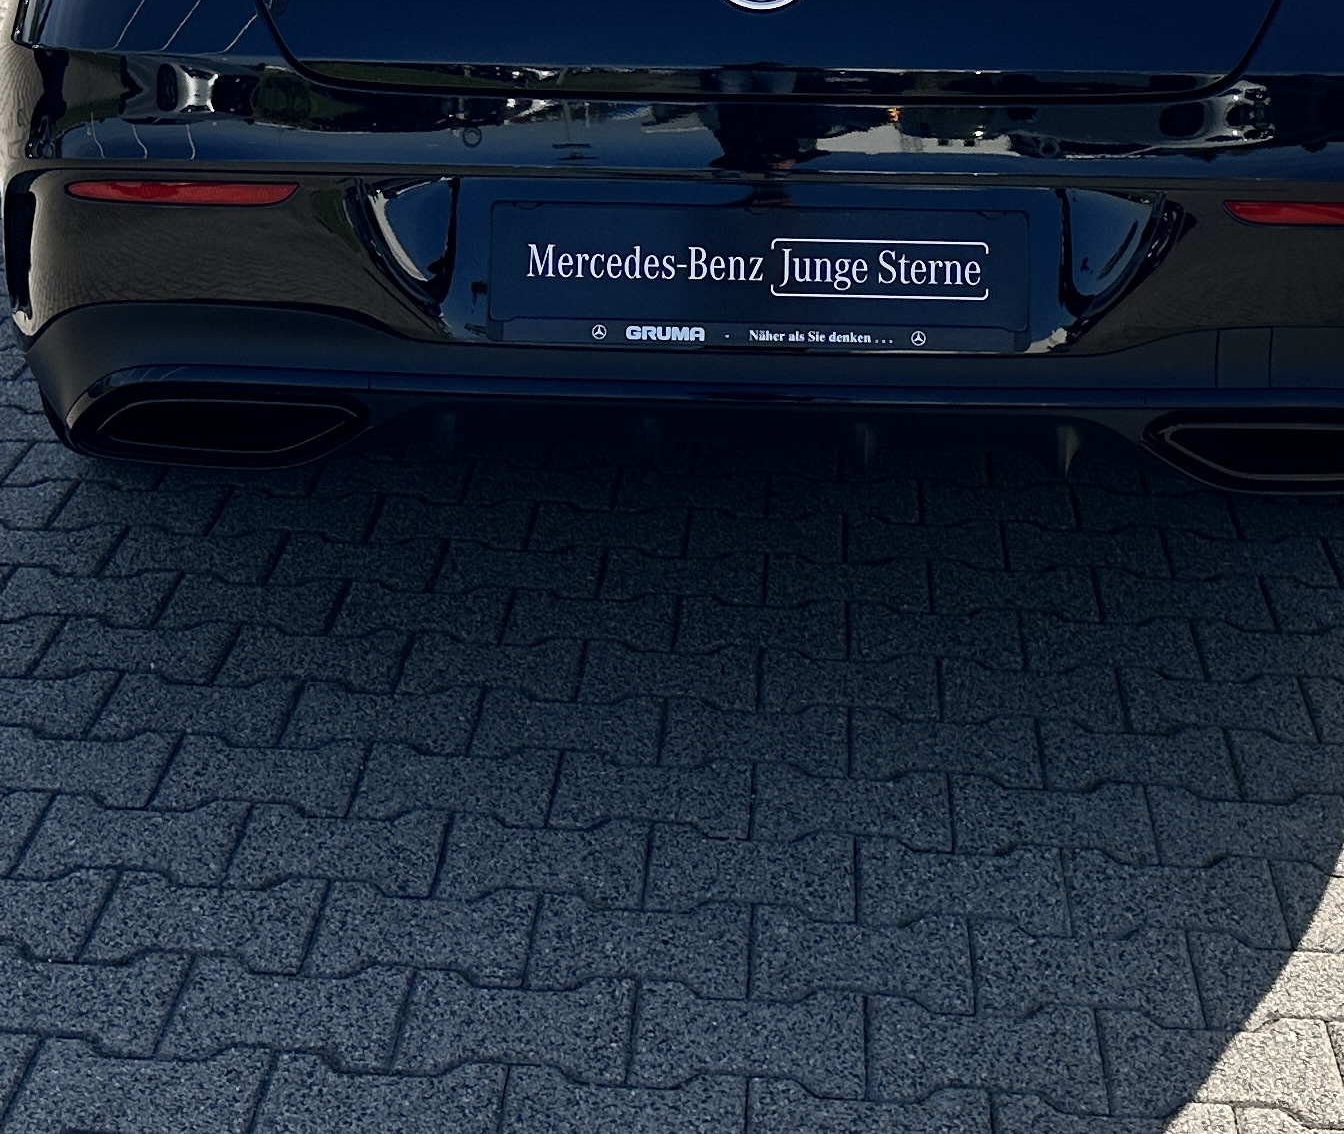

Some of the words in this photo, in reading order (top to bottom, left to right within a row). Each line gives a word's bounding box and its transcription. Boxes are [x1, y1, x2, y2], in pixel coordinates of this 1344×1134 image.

[525, 242, 765, 282] Mercedes-Benz
[778, 247, 869, 291] Junge
[877, 249, 982, 286] Sterne
[624, 324, 706, 342] GRUMA
[748, 329, 786, 342] Näher
[787, 330, 806, 342] als
[807, 330, 827, 343] Sie
[828, 331, 872, 344] denken
